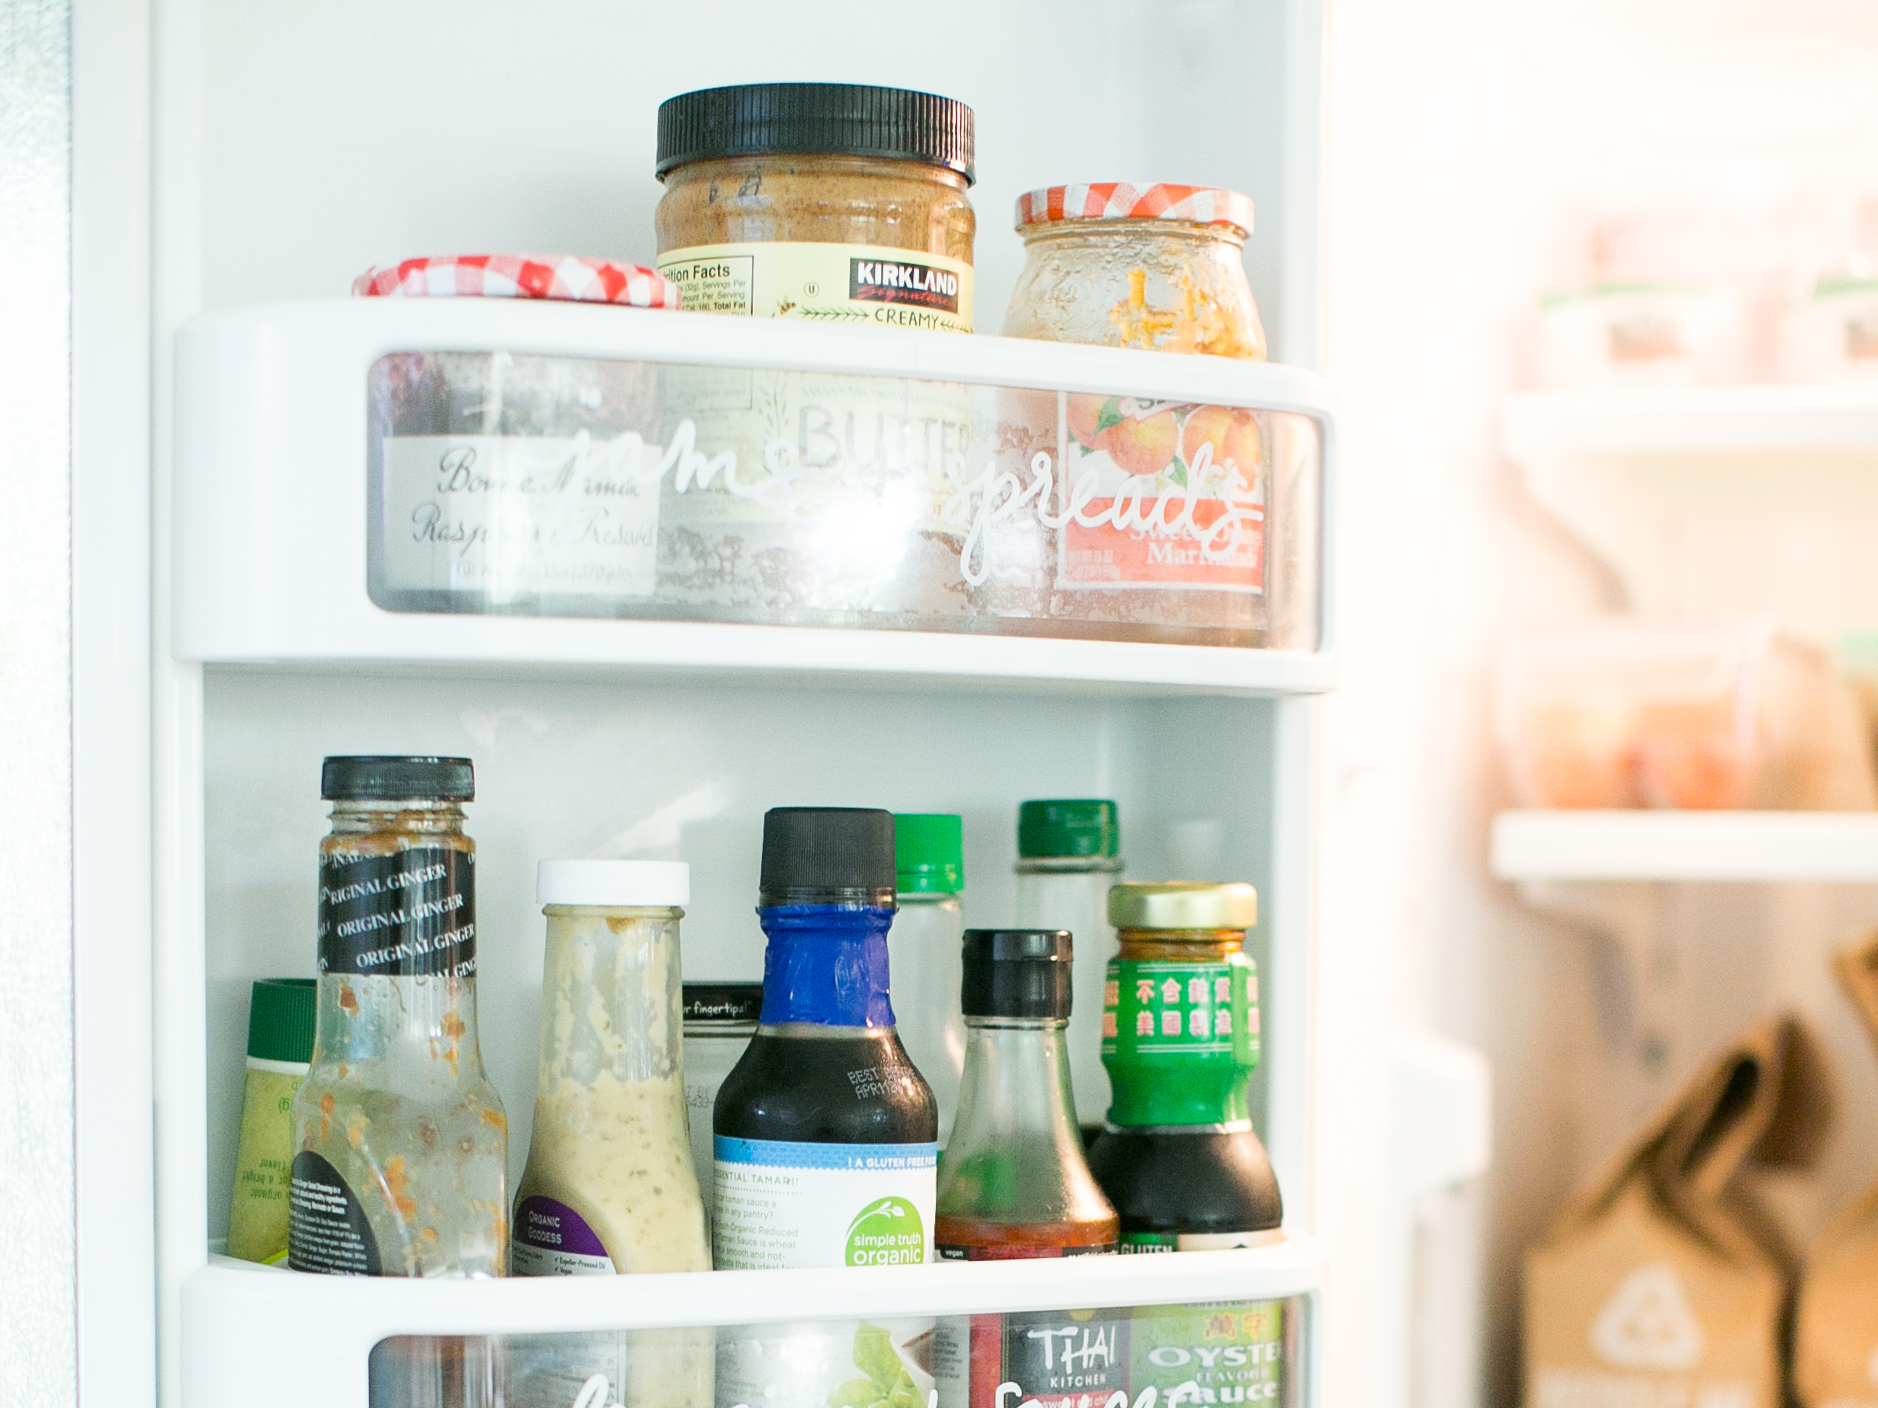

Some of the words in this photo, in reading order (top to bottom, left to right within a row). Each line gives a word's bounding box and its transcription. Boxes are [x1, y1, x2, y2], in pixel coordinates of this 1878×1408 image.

[663, 268, 689, 283] rition
[693, 264, 731, 280] Facts
[857, 261, 957, 296] KIRKLAND
[702, 280, 731, 291] Servings
[733, 279, 747, 289] Per
[682, 294, 700, 302] mount
[702, 292, 714, 301] Per
[856, 285, 950, 304] Signature
[713, 302, 732, 310] Total
[734, 301, 747, 309] Fat
[874, 307, 940, 330] CREAMY
[520, 418, 823, 556] jams
[940, 440, 1265, 587] spreads
[330, 878, 387, 906] RIGINAL
[386, 863, 448, 891] GINGER
[337, 909, 411, 938] ORIGINAL
[410, 893, 464, 920] GINGER
[355, 939, 434, 969] ORIGINAL
[434, 922, 475, 951] GINGER
[847, 1067, 879, 1086] BEST
[854, 1157, 864, 1168] A
[866, 1156, 905, 1168] GLUTEN
[906, 1156, 925, 1167] FREE
[249, 1188, 283, 1202] organic
[746, 1198, 770, 1208] sauce
[528, 1210, 561, 1228] ORGANIC
[743, 1210, 774, 1221] pantry?
[527, 1226, 563, 1245] GODDESS
[730, 1222, 757, 1234] Organic
[758, 1225, 799, 1238] Reduced
[736, 1236, 758, 1247] Sauce
[759, 1239, 767, 1248] is
[768, 1240, 797, 1250] wheat
[854, 1233, 896, 1248] simple
[897, 1232, 922, 1246] truth
[750, 1250, 765, 1260] and
[767, 1252, 786, 1261] not-
[853, 1246, 922, 1267] organic
[945, 1249, 964, 1258] vegan
[1027, 1326, 1116, 1375] THAI
[1148, 1342, 1281, 1368] OYSTE
[1050, 1373, 1107, 1389] KITCHEN
